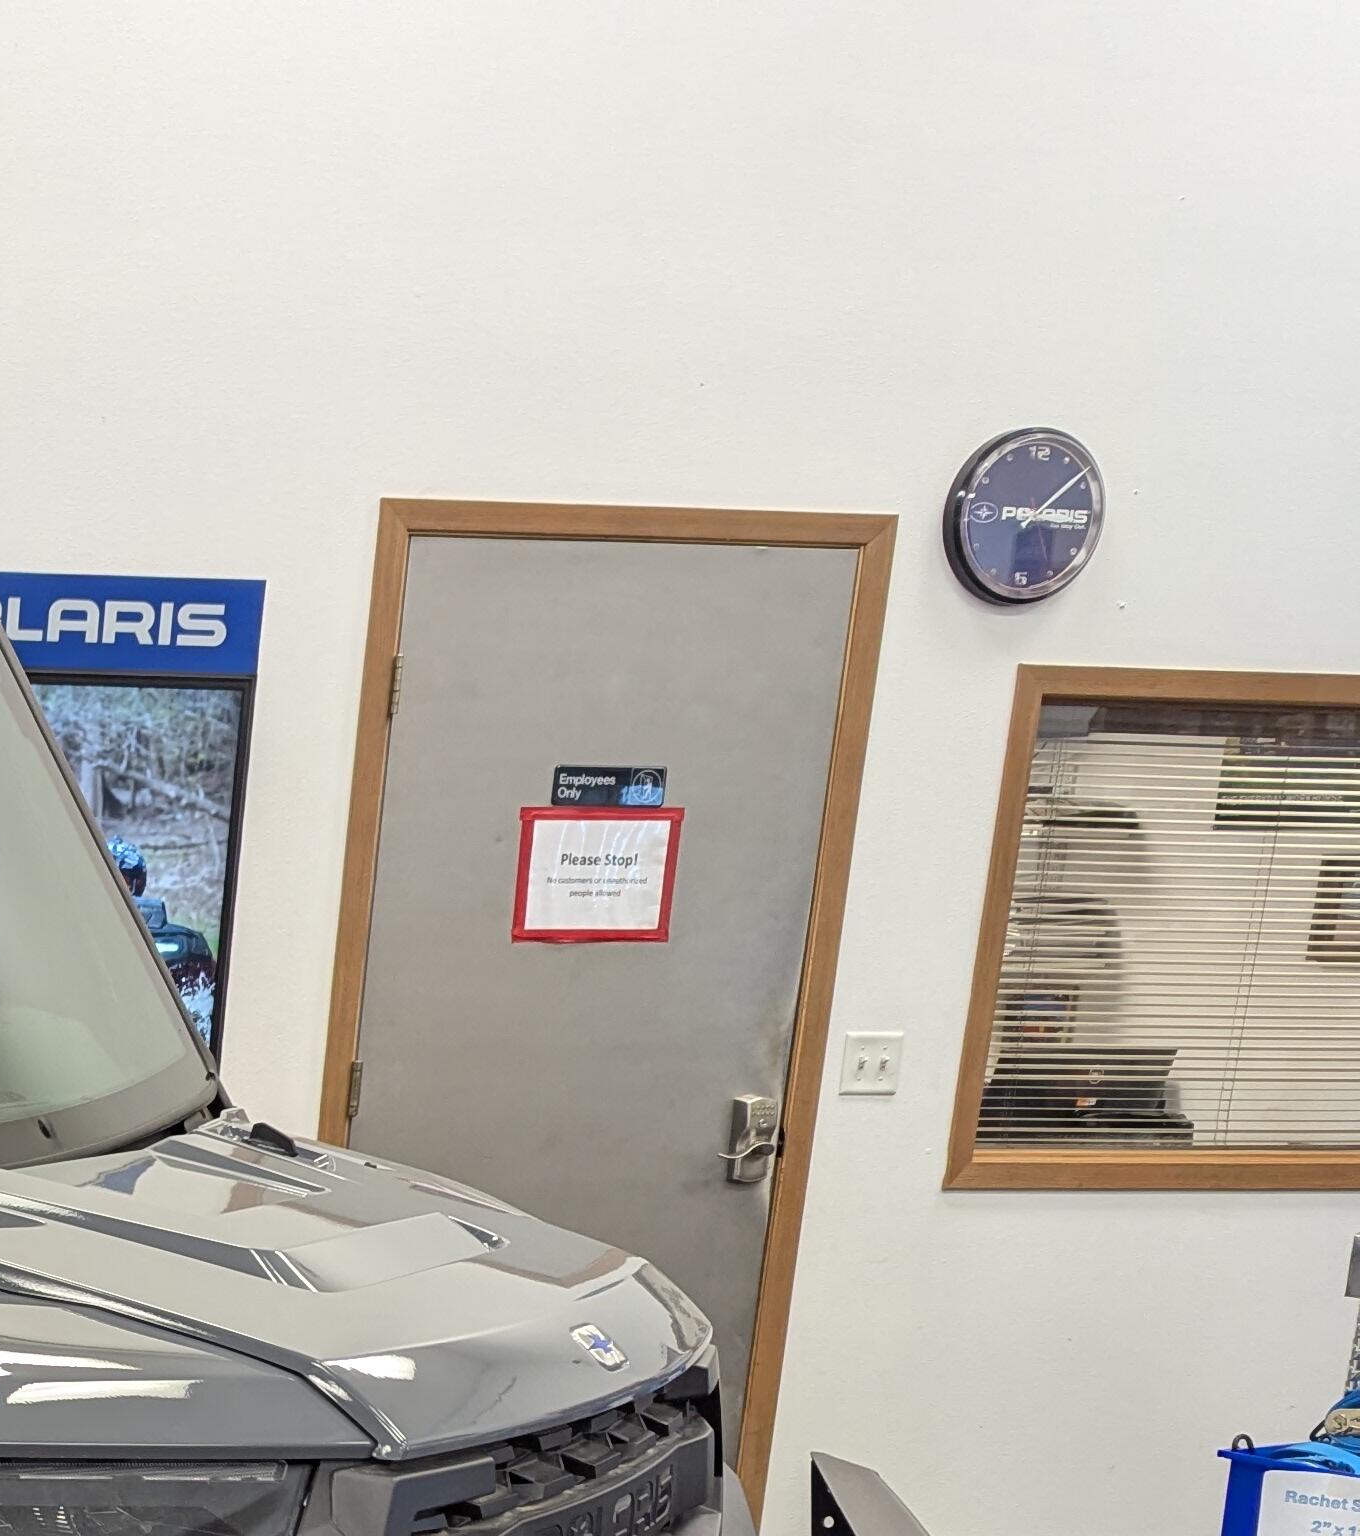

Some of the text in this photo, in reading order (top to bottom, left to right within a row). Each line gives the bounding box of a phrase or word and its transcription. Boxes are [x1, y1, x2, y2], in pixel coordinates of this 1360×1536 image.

[1028, 445, 1051, 461] 12
[1014, 571, 1028, 586] 6
[559, 773, 616, 786] Employees
[557, 787, 581, 800] Only
[560, 853, 638, 868] Please Stop!
[569, 889, 593, 897] people
[1285, 1490, 1349, 1511] Rachet
